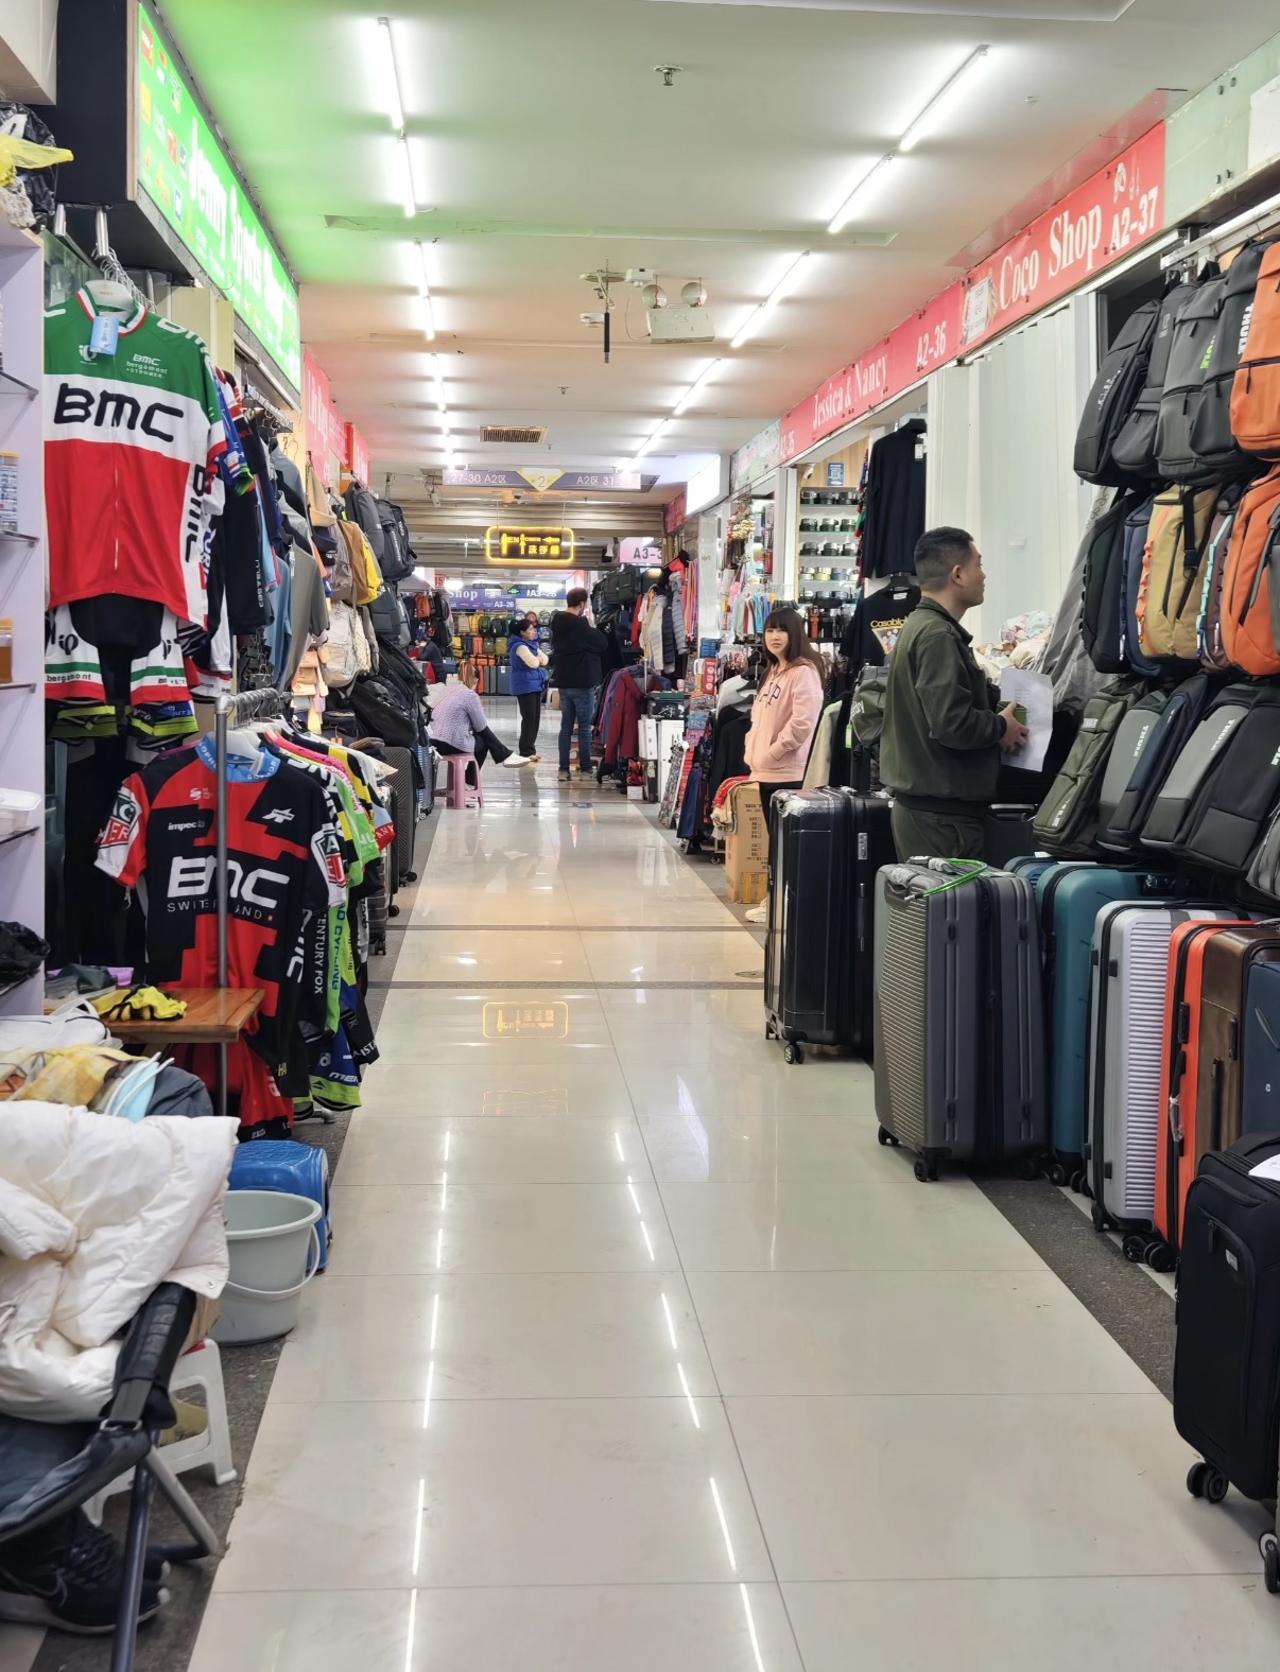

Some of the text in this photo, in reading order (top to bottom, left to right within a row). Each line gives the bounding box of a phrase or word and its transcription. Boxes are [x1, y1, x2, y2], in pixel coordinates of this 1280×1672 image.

[1109, 186, 1159, 255] A2-37
[1000, 250, 1040, 311] Coco
[1049, 204, 1102, 279] Shop
[915, 321, 947, 368] A2-36
[54, 383, 184, 443] BMC
[812, 381, 845, 431] Jessica
[855, 356, 888, 398] Nancy
[167, 855, 290, 909] BMC
[314, 914, 327, 994] ENTURY FOX
